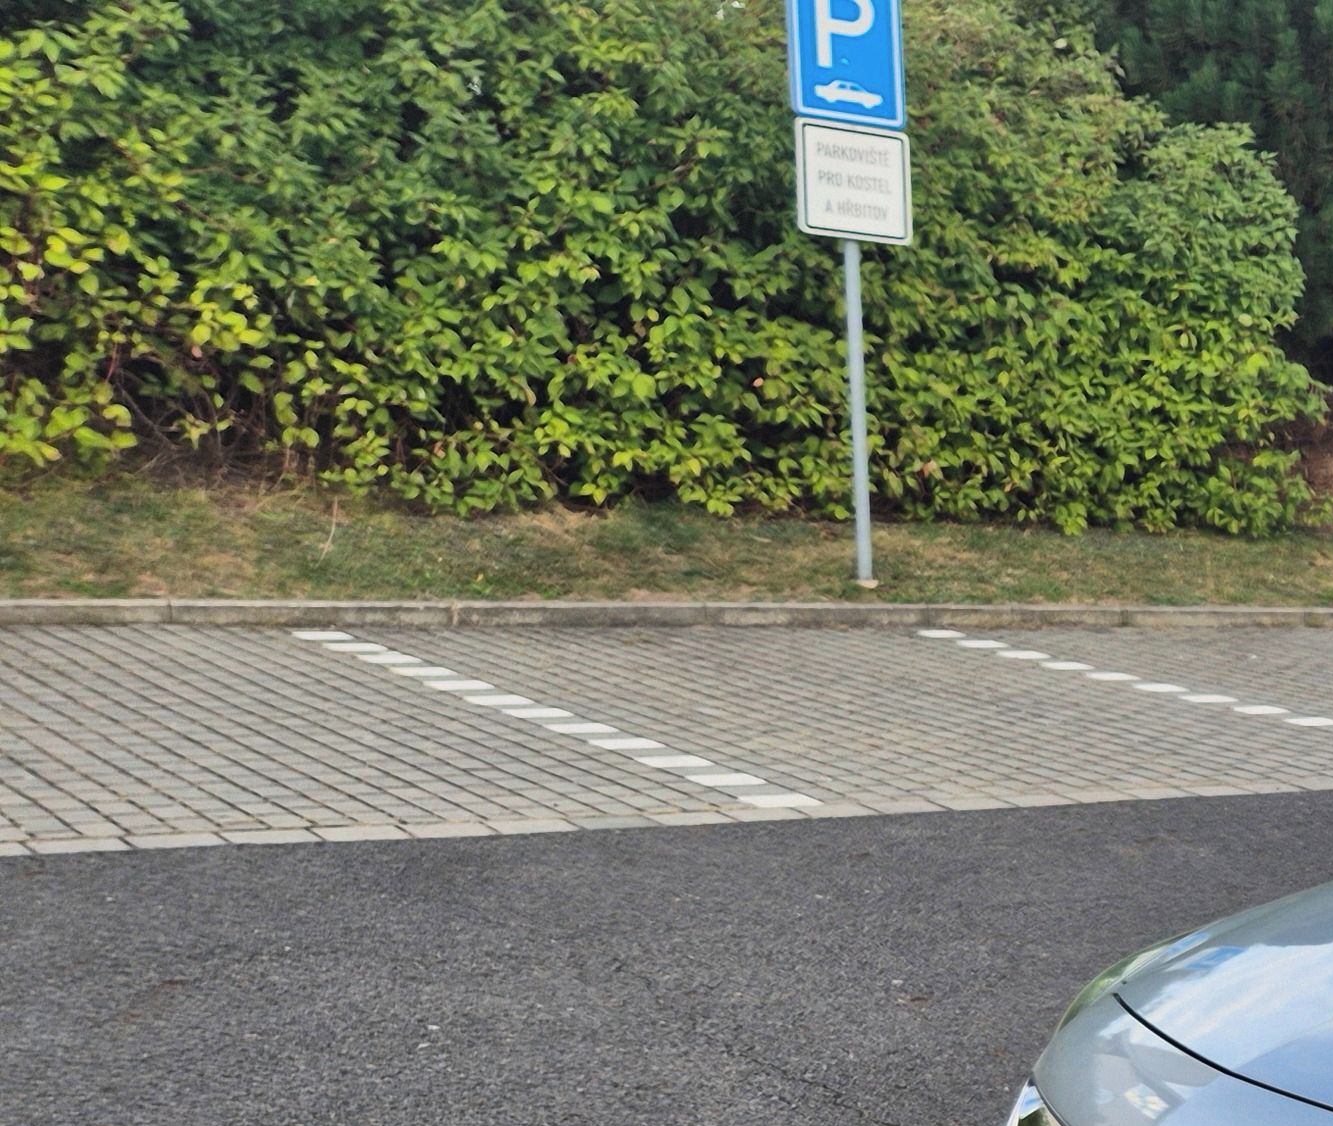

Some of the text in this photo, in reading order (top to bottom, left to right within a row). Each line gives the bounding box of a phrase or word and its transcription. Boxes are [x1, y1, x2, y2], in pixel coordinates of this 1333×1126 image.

[814, 0, 875, 68] P
[818, 169, 892, 195] PRO KOSTEL
[825, 200, 833, 213] A
